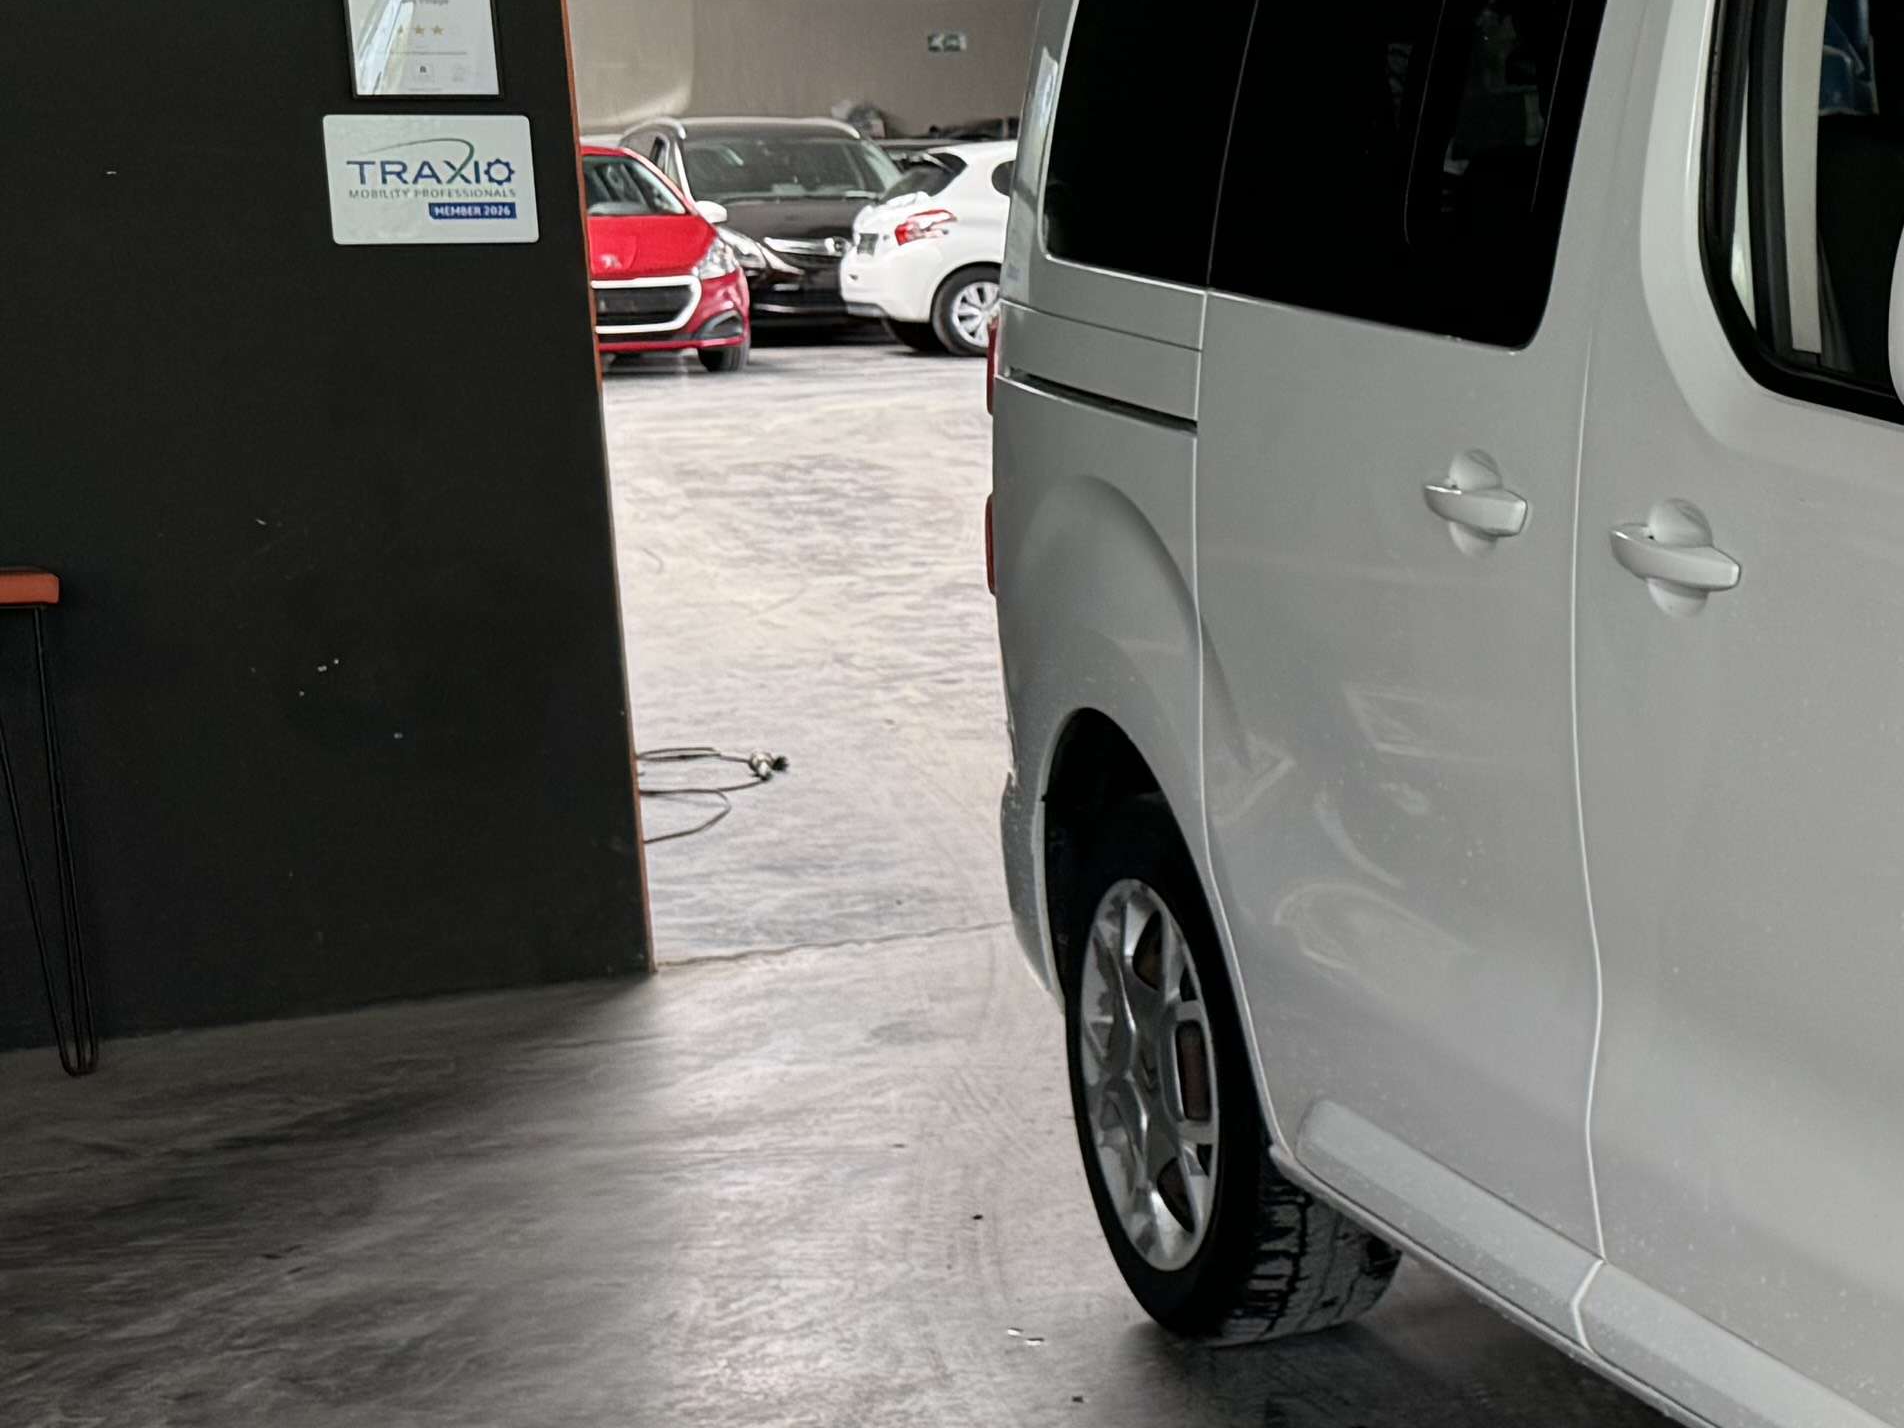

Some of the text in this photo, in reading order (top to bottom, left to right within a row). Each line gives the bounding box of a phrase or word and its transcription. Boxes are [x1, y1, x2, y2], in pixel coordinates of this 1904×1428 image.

[346, 158, 515, 186] TRAXIO
[349, 187, 516, 199] MOBILITY PROFESSIONALS
[434, 205, 511, 217] MEMBER 2026
